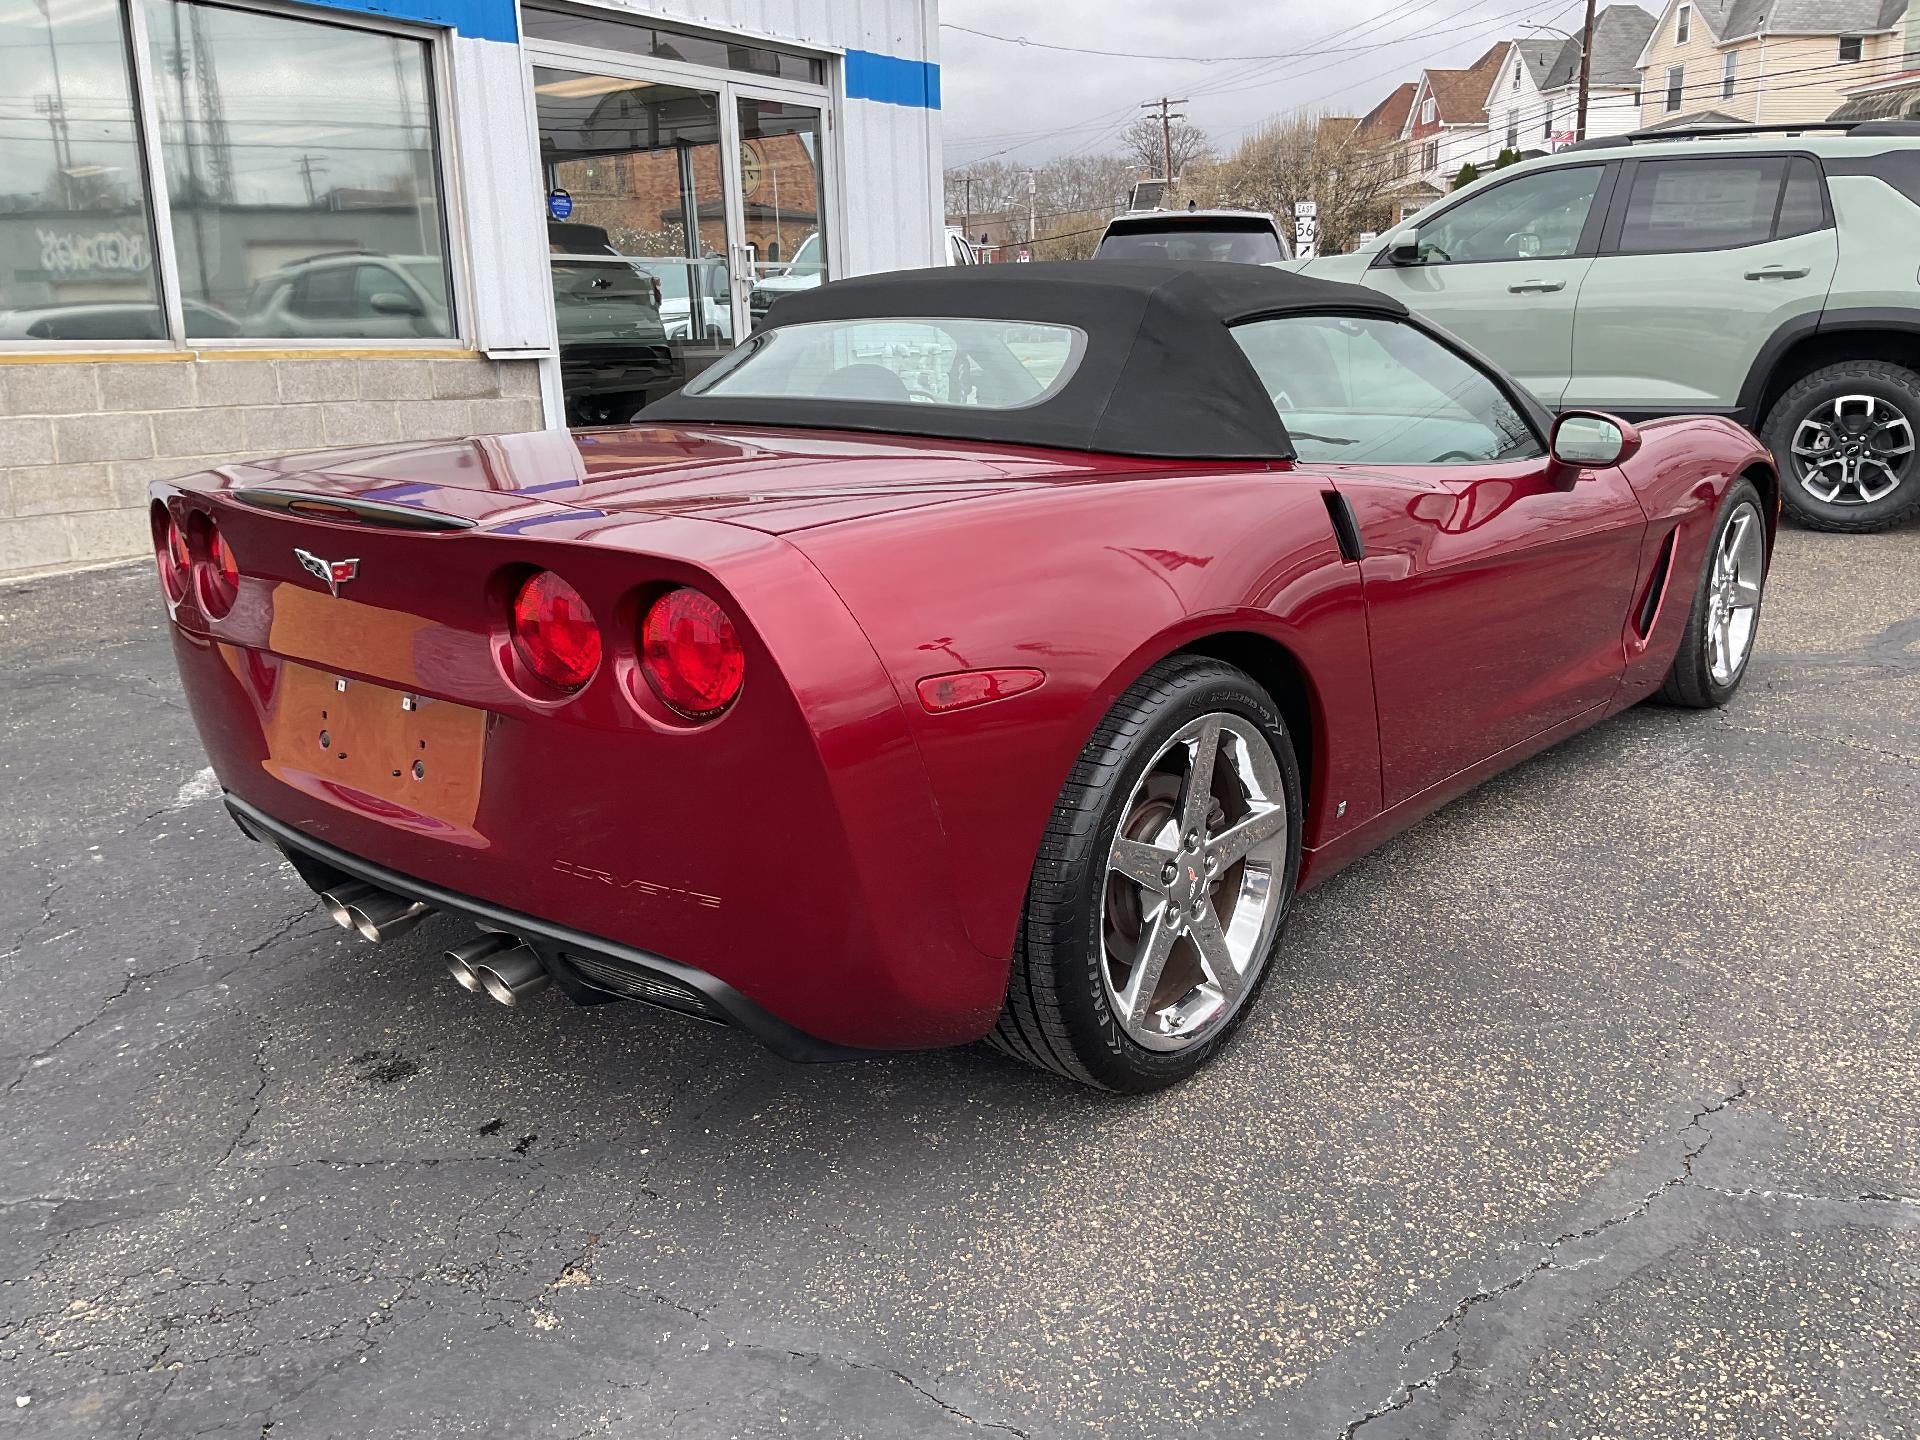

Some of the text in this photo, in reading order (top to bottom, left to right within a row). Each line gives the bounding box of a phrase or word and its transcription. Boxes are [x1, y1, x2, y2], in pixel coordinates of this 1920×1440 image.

[1298, 205, 1313, 213] EAST
[1297, 223, 1314, 236] 56
[552, 859, 722, 908] CORVETTE
[1086, 951, 1110, 1026] EAGLE
